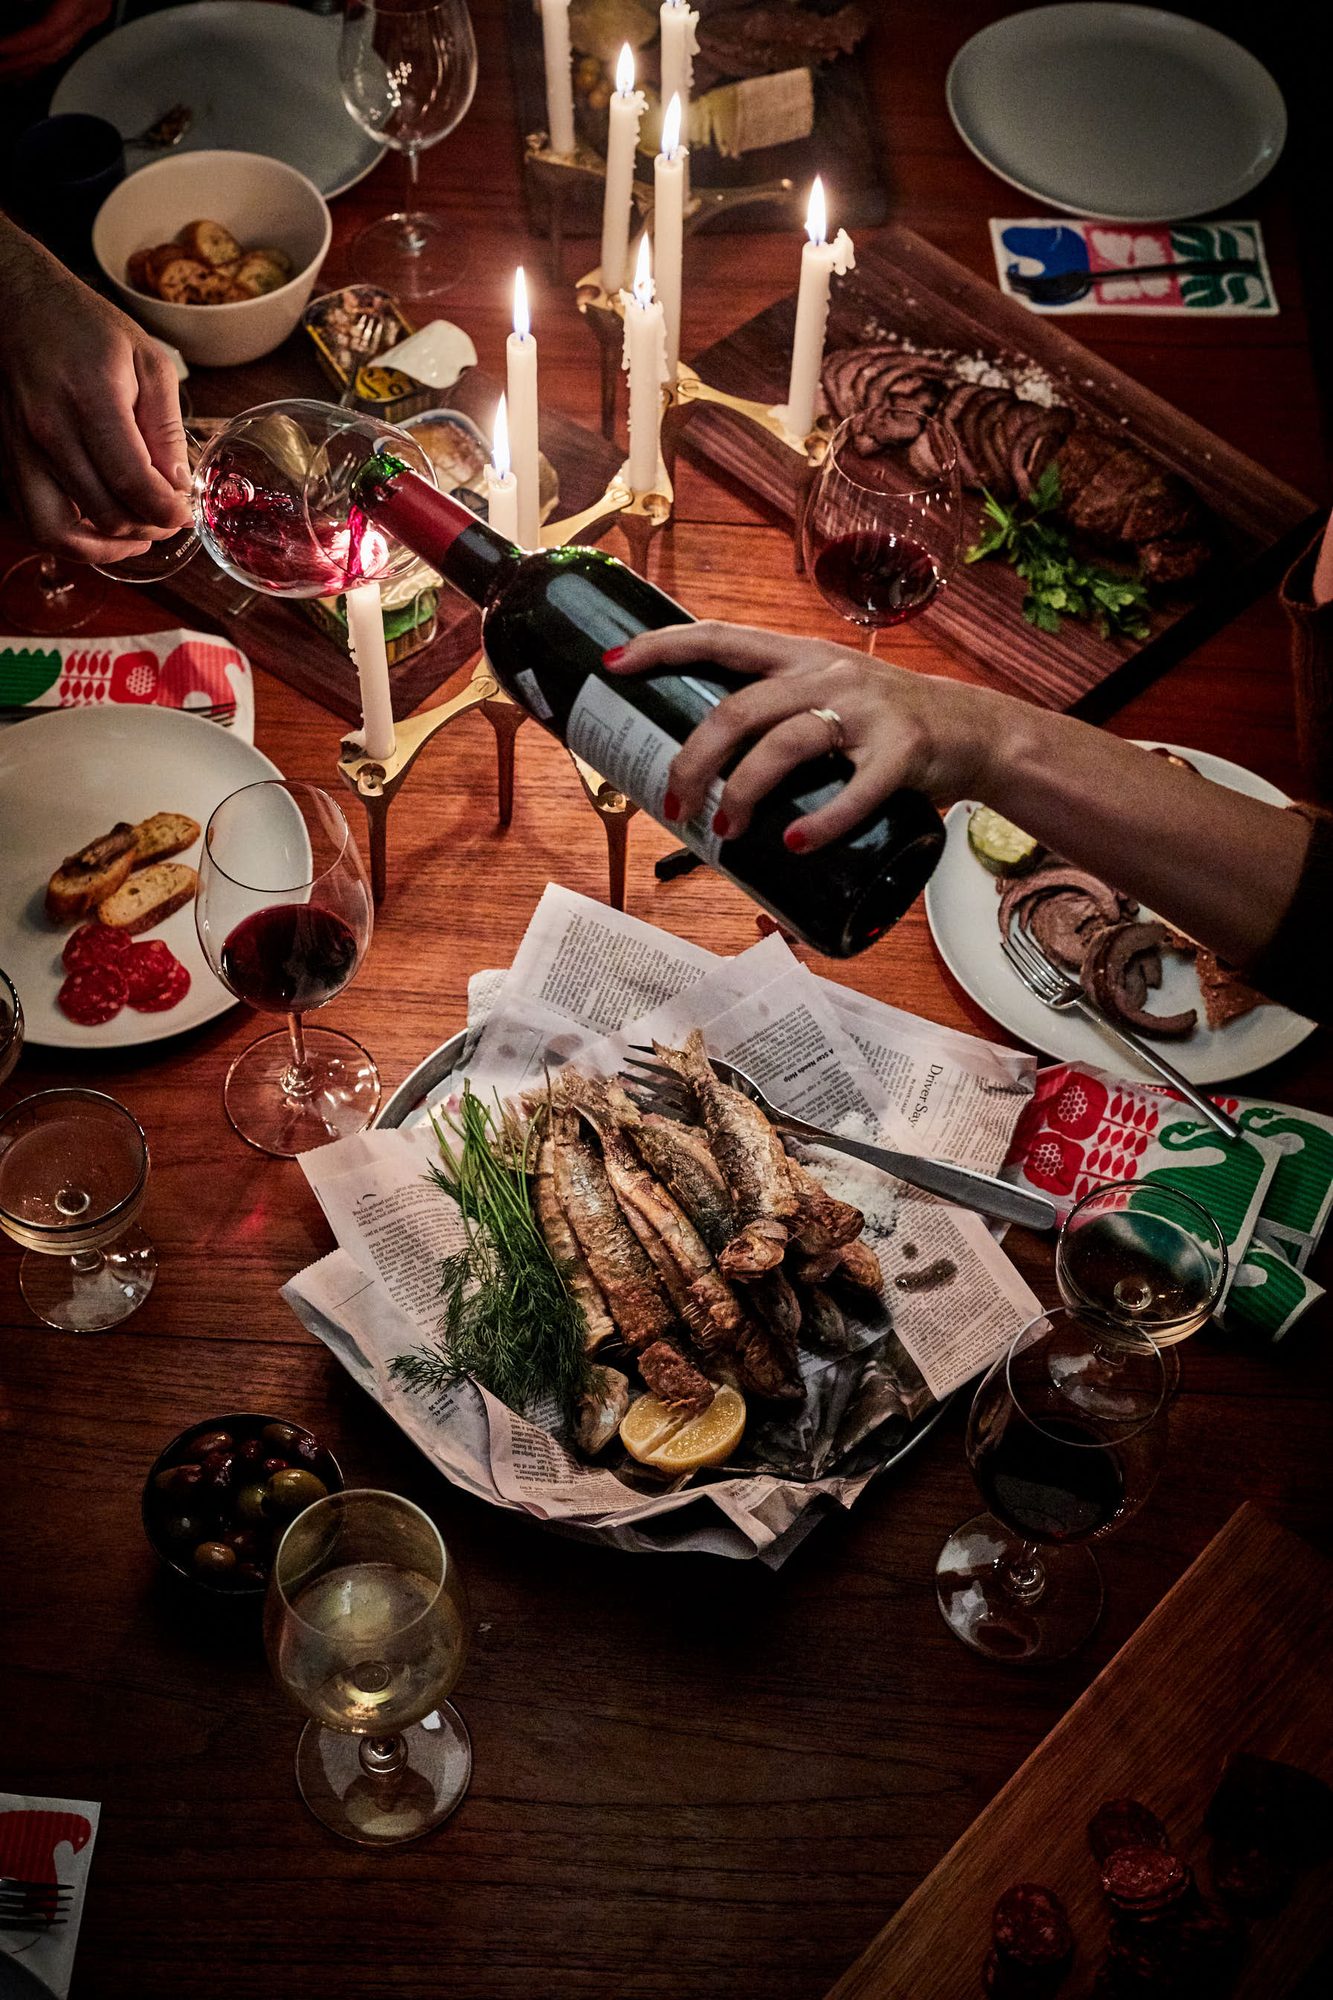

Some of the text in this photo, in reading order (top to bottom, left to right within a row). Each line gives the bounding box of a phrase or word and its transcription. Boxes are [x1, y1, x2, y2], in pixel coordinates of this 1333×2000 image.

[782, 1047, 835, 1085] A Star Needs Help
[907, 1063, 944, 1130] Driver Say
